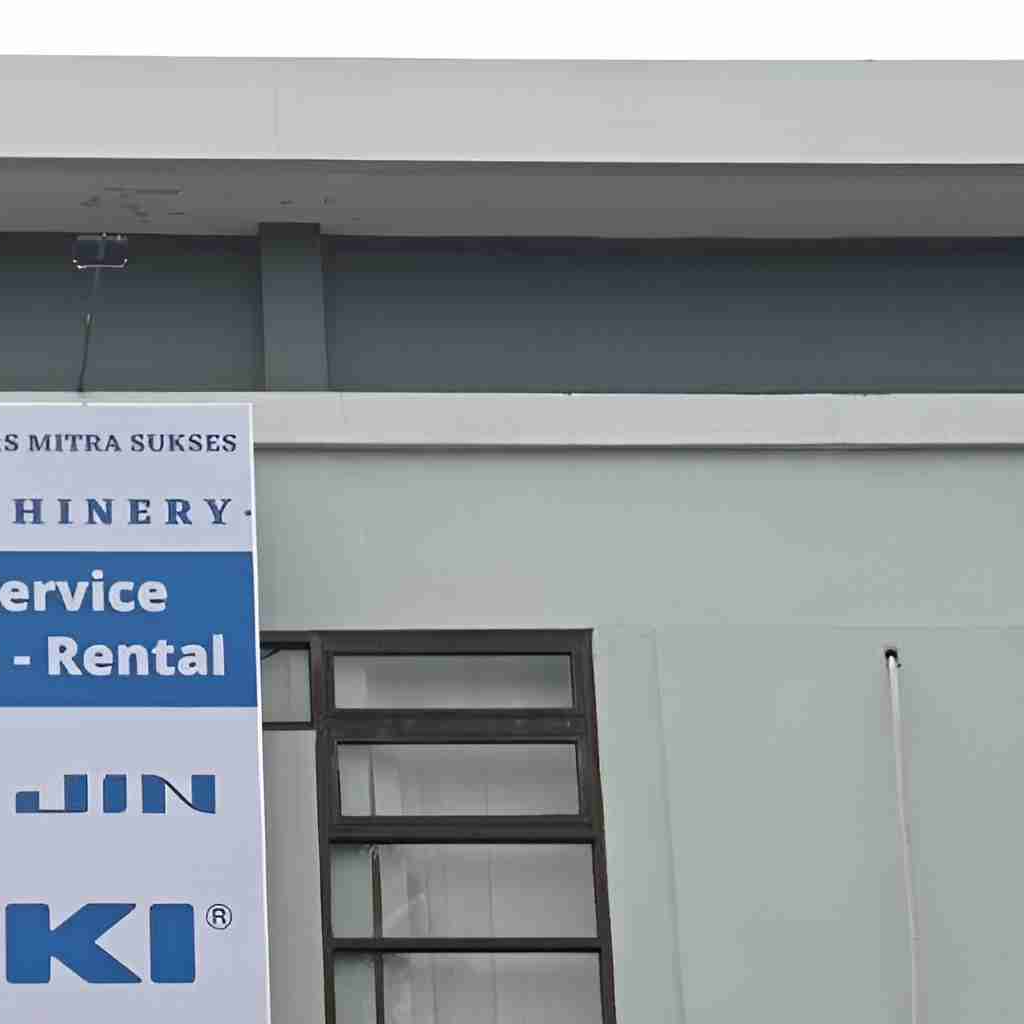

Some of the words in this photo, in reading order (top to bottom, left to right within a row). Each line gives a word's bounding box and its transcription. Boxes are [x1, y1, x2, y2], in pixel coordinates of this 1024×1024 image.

[29, 433, 122, 453] MITRA
[131, 433, 237, 453] SUKSES
[48, 634, 225, 676] Rental
[15, 774, 216, 814] JIN
